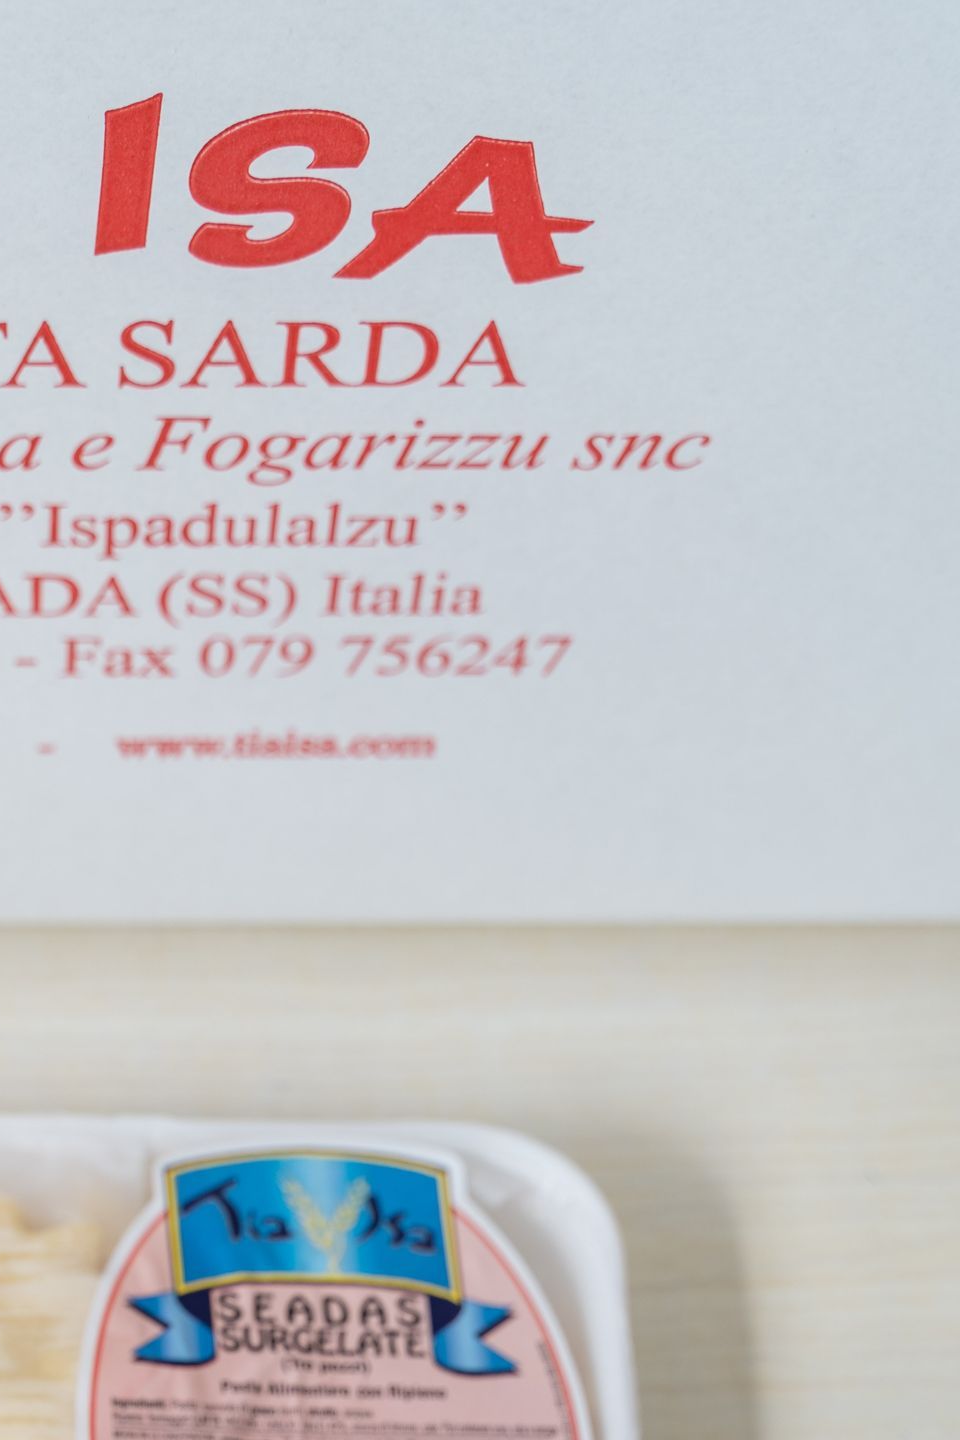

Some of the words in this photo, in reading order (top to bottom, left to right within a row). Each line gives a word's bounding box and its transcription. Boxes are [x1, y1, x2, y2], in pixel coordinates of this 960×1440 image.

[94, 92, 595, 285] ISA
[117, 319, 525, 389] SARDA
[71, 434, 115, 471] e
[137, 416, 549, 486] Fogarizzu
[570, 433, 711, 470] snc
[156, 573, 298, 625] (SS)
[325, 571, 481, 616] Italia
[63, 635, 174, 678] Fax
[197, 634, 316, 677] 079
[341, 634, 573, 677] 756247
[114, 729, 437, 759] www.tiaisa.com
[182, 1178, 294, 1244] Tia
[215, 1292, 422, 1329] SEADAS
[219, 1323, 427, 1359] SURGELATE
